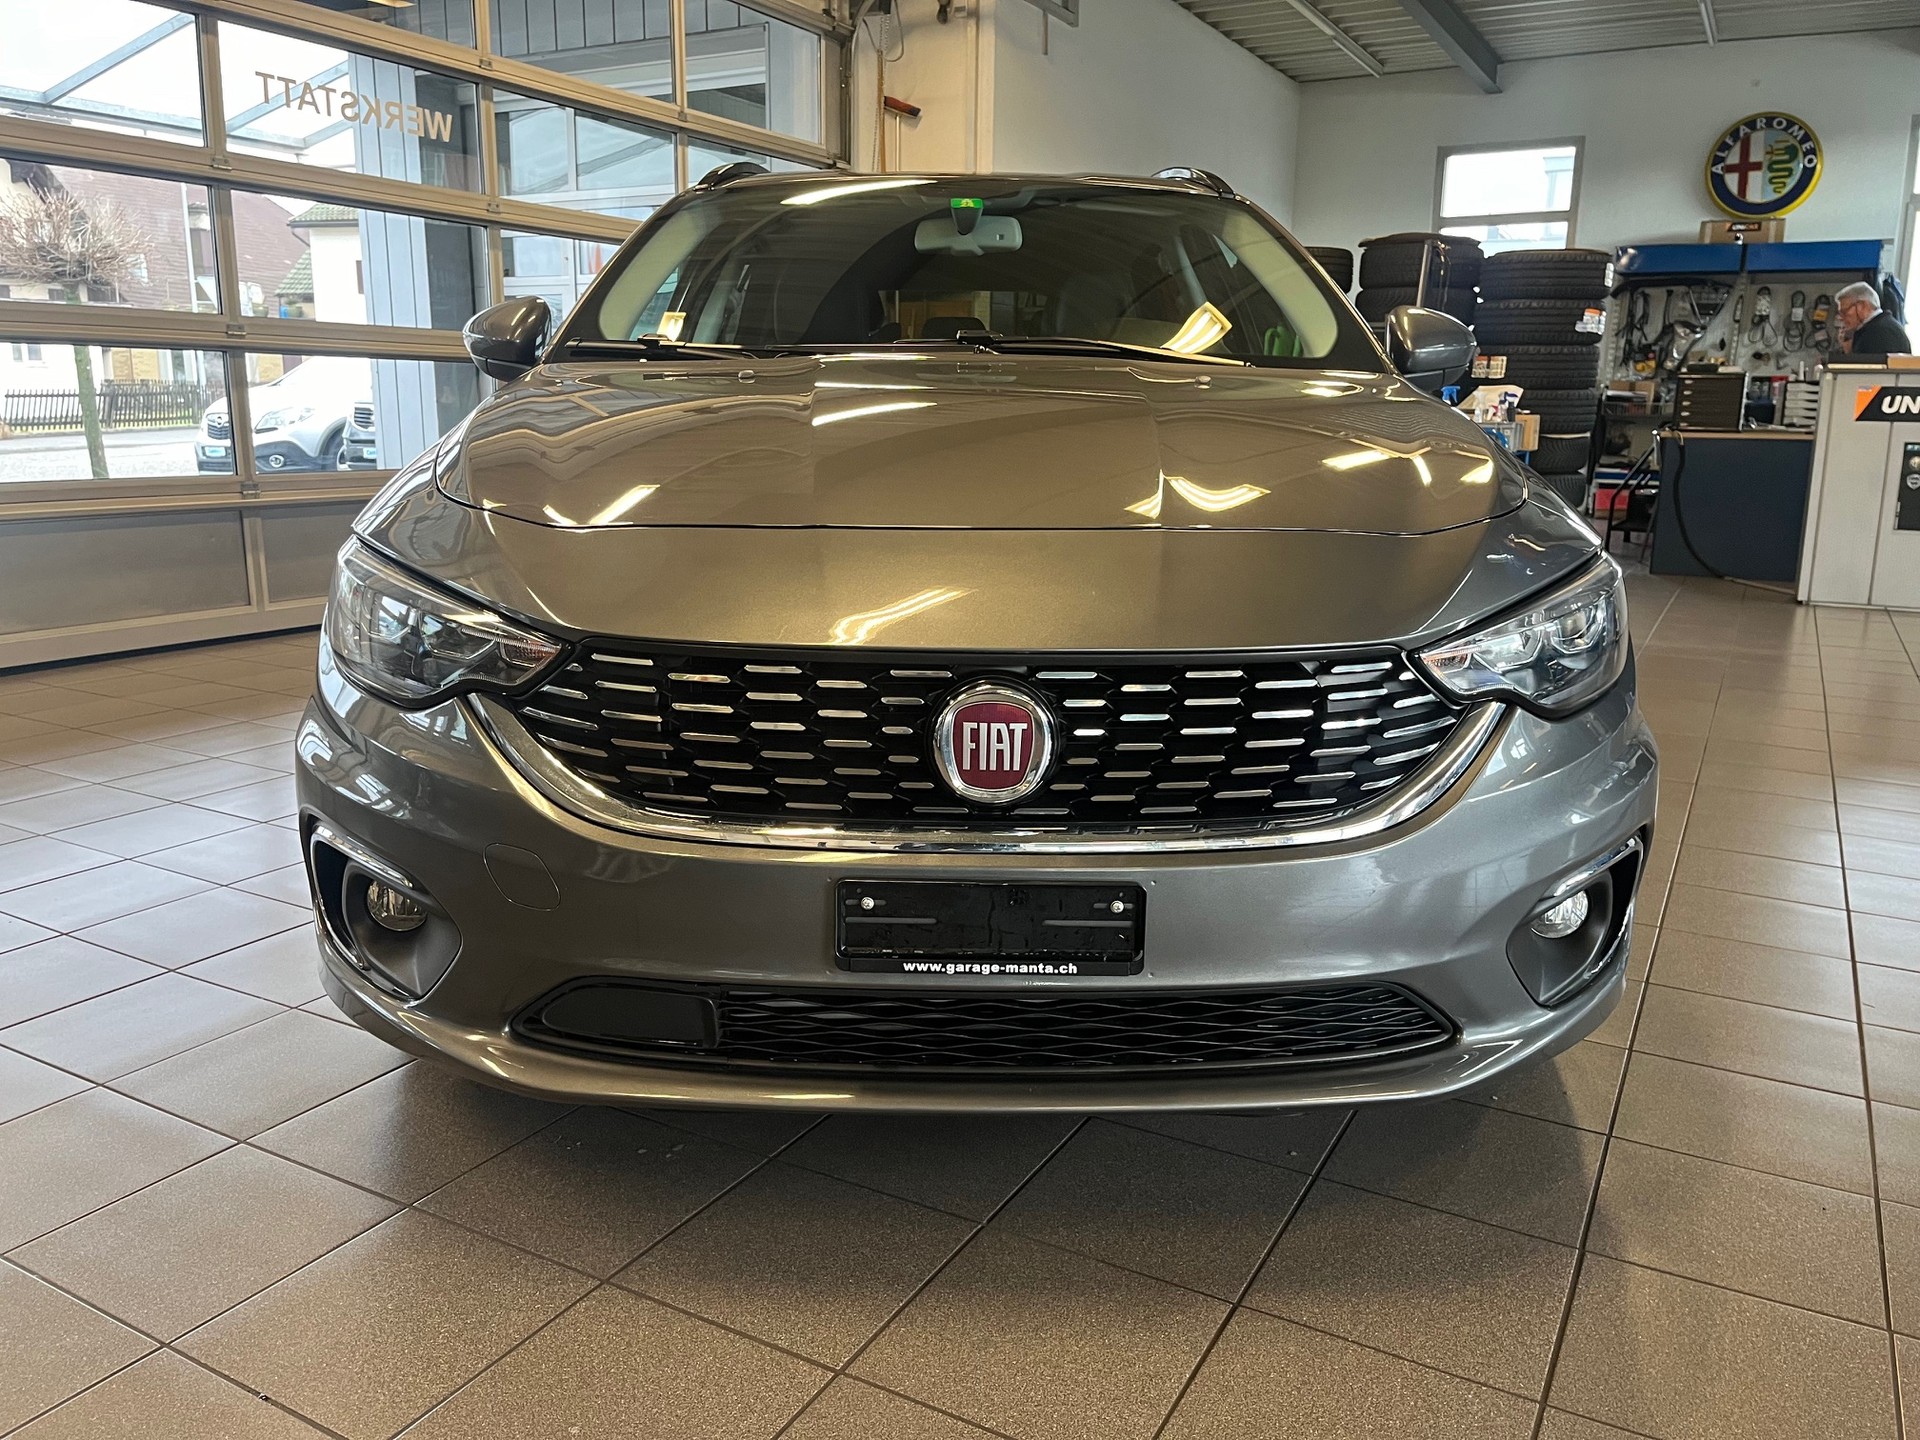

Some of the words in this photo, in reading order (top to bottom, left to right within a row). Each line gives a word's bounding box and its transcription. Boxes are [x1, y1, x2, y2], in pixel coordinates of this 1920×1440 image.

[1711, 124, 1752, 176] ALFA
[1756, 117, 1818, 169] ROMEO
[962, 721, 1028, 771] FIAT
[903, 962, 1078, 975] www.garage-manta.ch
